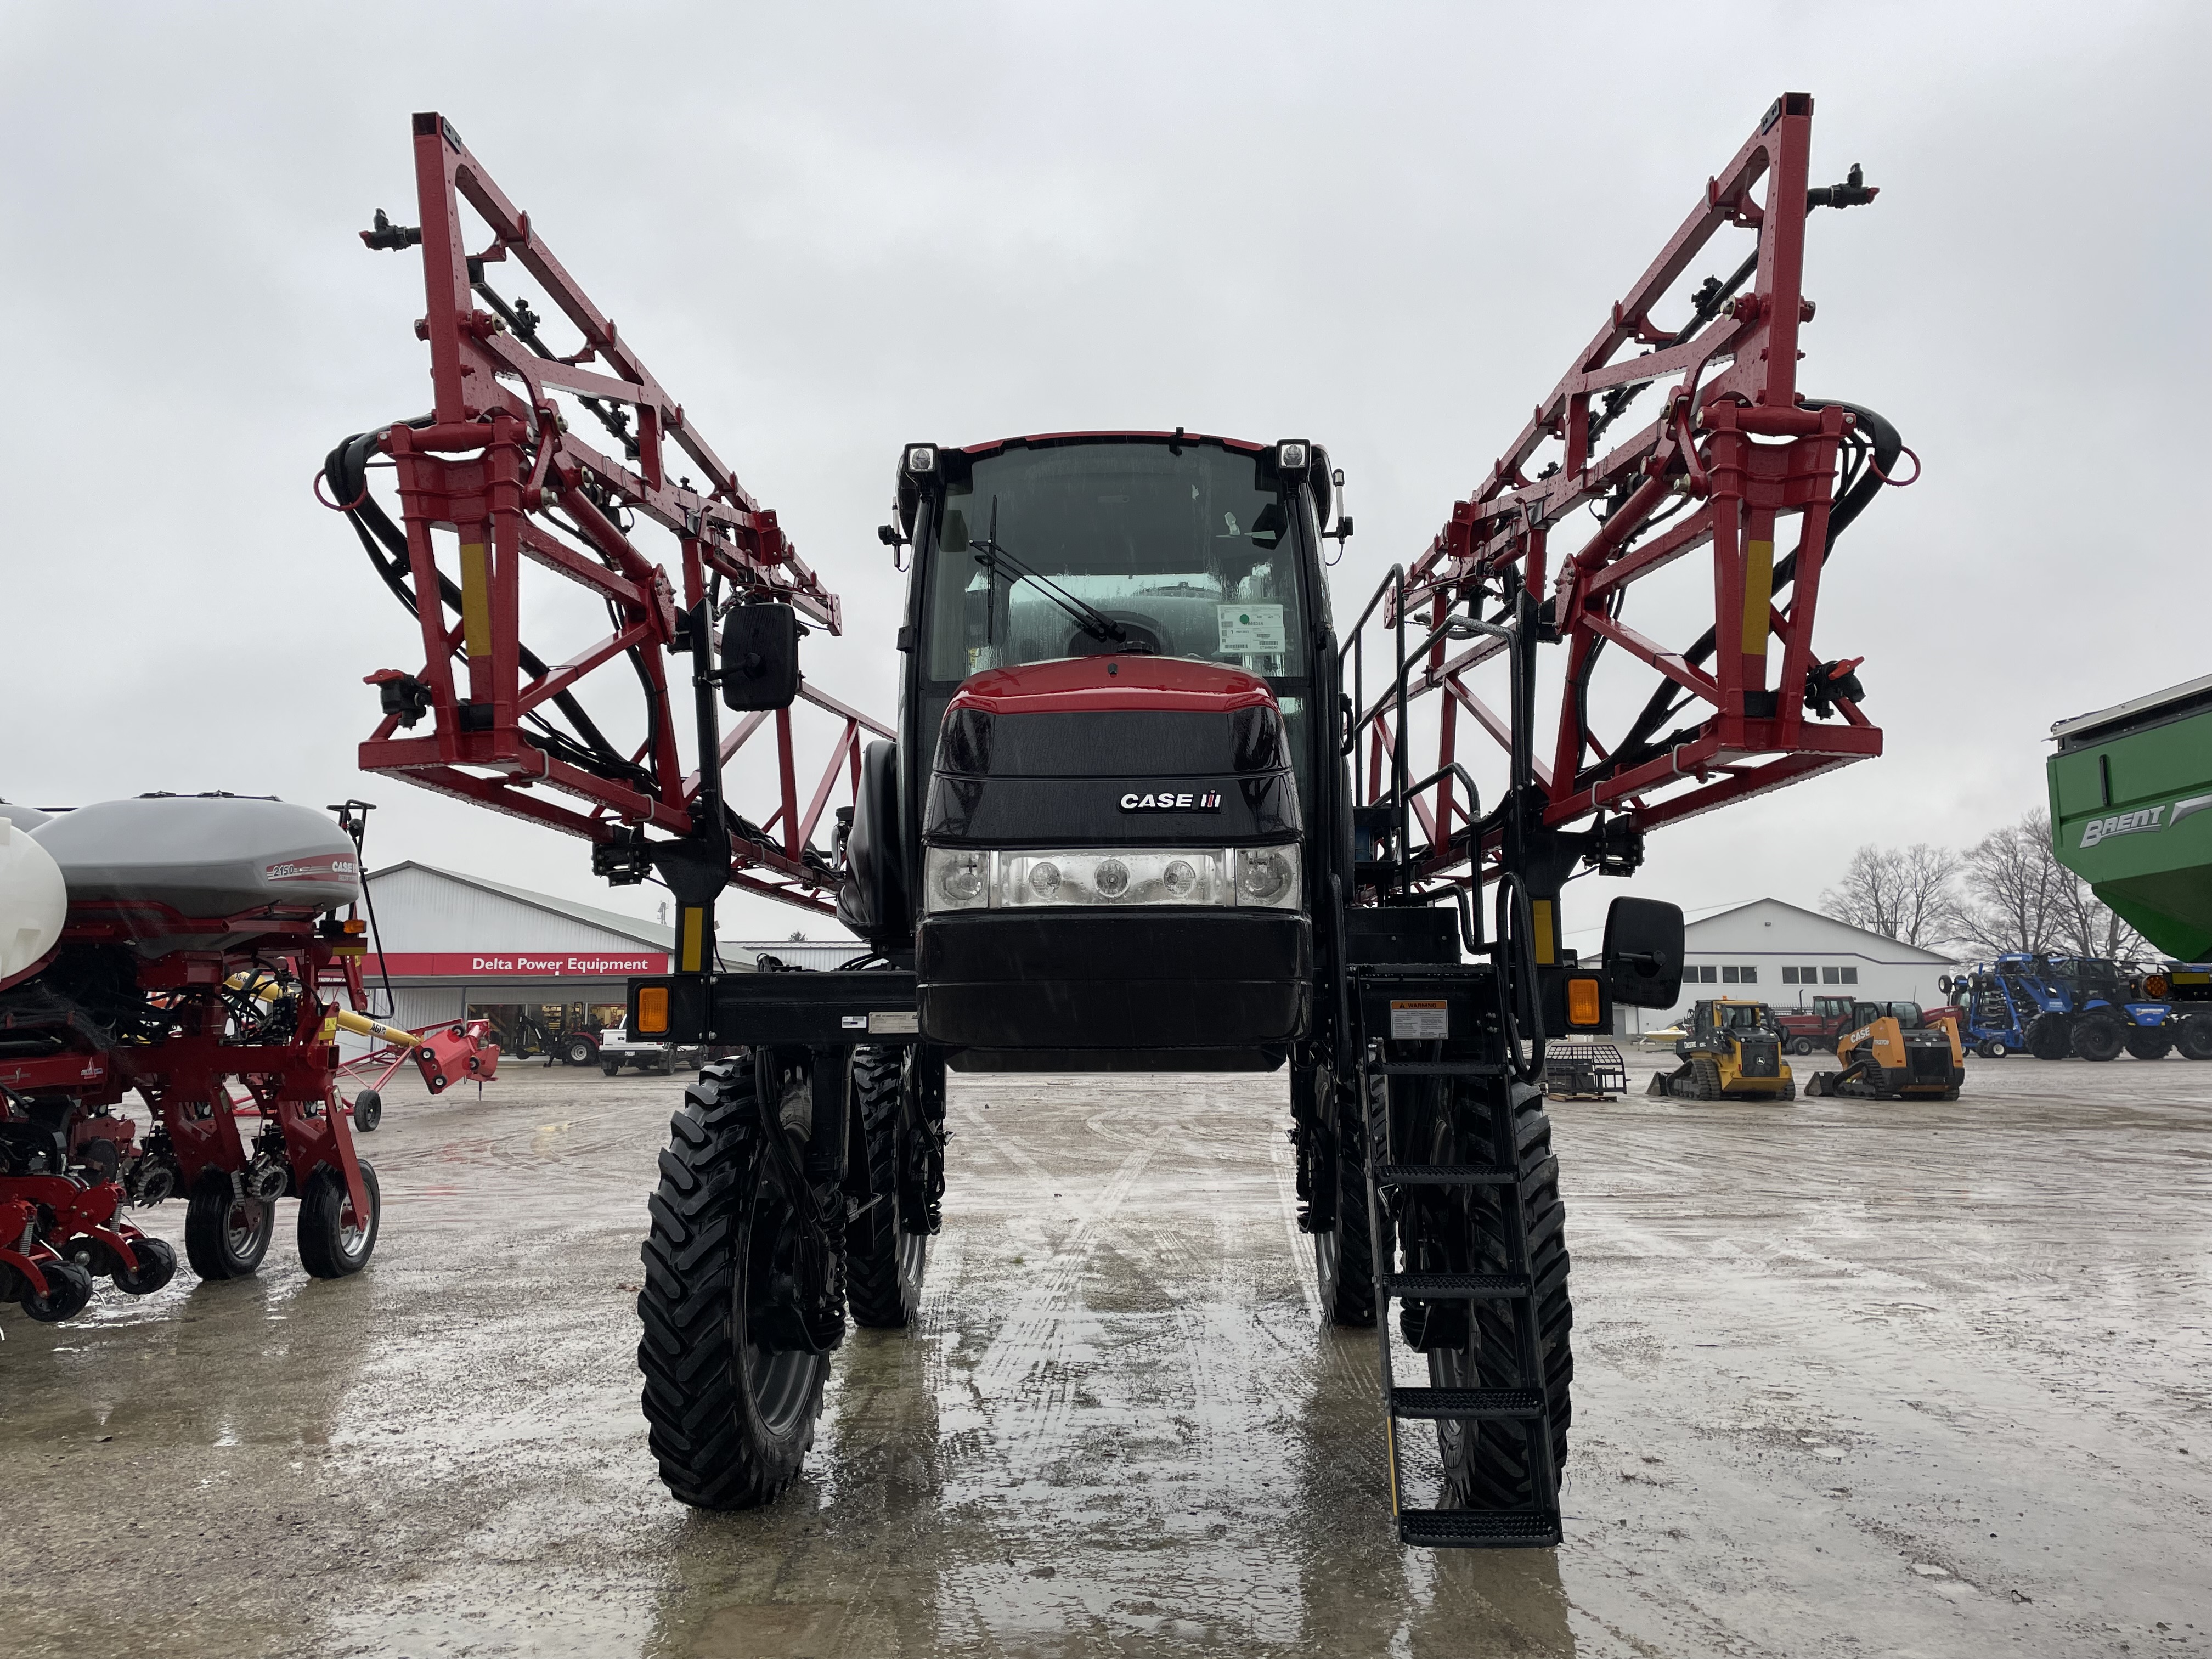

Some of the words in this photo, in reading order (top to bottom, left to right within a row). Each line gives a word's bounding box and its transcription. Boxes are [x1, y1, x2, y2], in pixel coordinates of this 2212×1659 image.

[1121, 793, 1194, 809] CASE
[2079, 805, 2165, 849] BRENT
[273, 864, 294, 877] 2150
[332, 861, 352, 873] CASE
[472, 958, 513, 970] Delta
[517, 958, 563, 970] Power
[568, 958, 648, 973] Equipment
[1850, 1026, 1870, 1043] CASE
